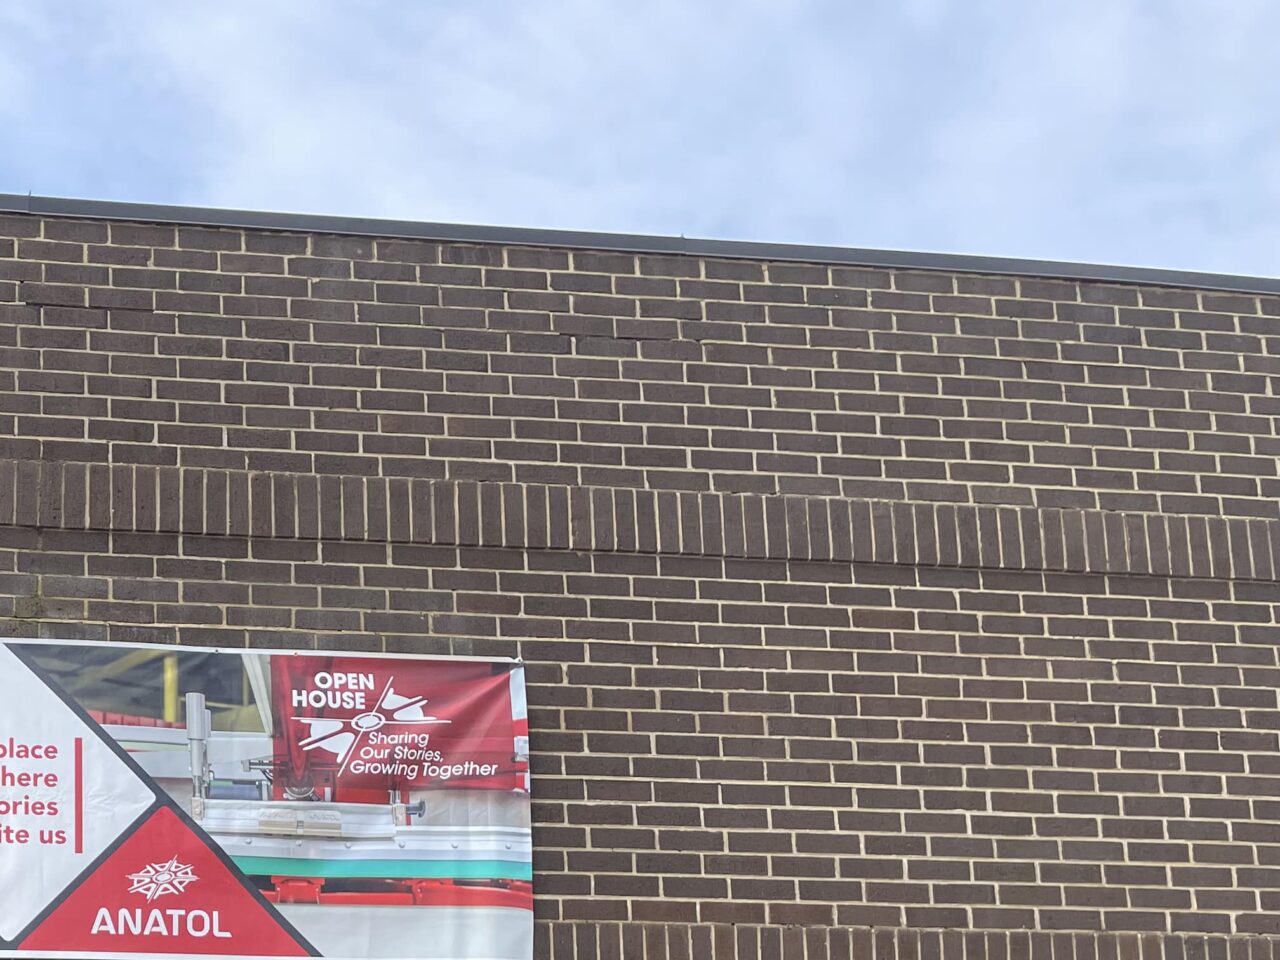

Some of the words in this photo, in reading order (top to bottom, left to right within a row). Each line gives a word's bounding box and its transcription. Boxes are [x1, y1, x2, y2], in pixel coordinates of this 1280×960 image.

[314, 671, 374, 690] OPEN
[292, 688, 366, 710] HOUSE
[368, 730, 429, 748] Sharing
[360, 745, 388, 760] Our
[392, 746, 444, 763] Stories,
[350, 760, 420, 779] Growing
[422, 760, 498, 778] Together
[38, 827, 67, 844] us
[90, 907, 232, 938] ANATOL
